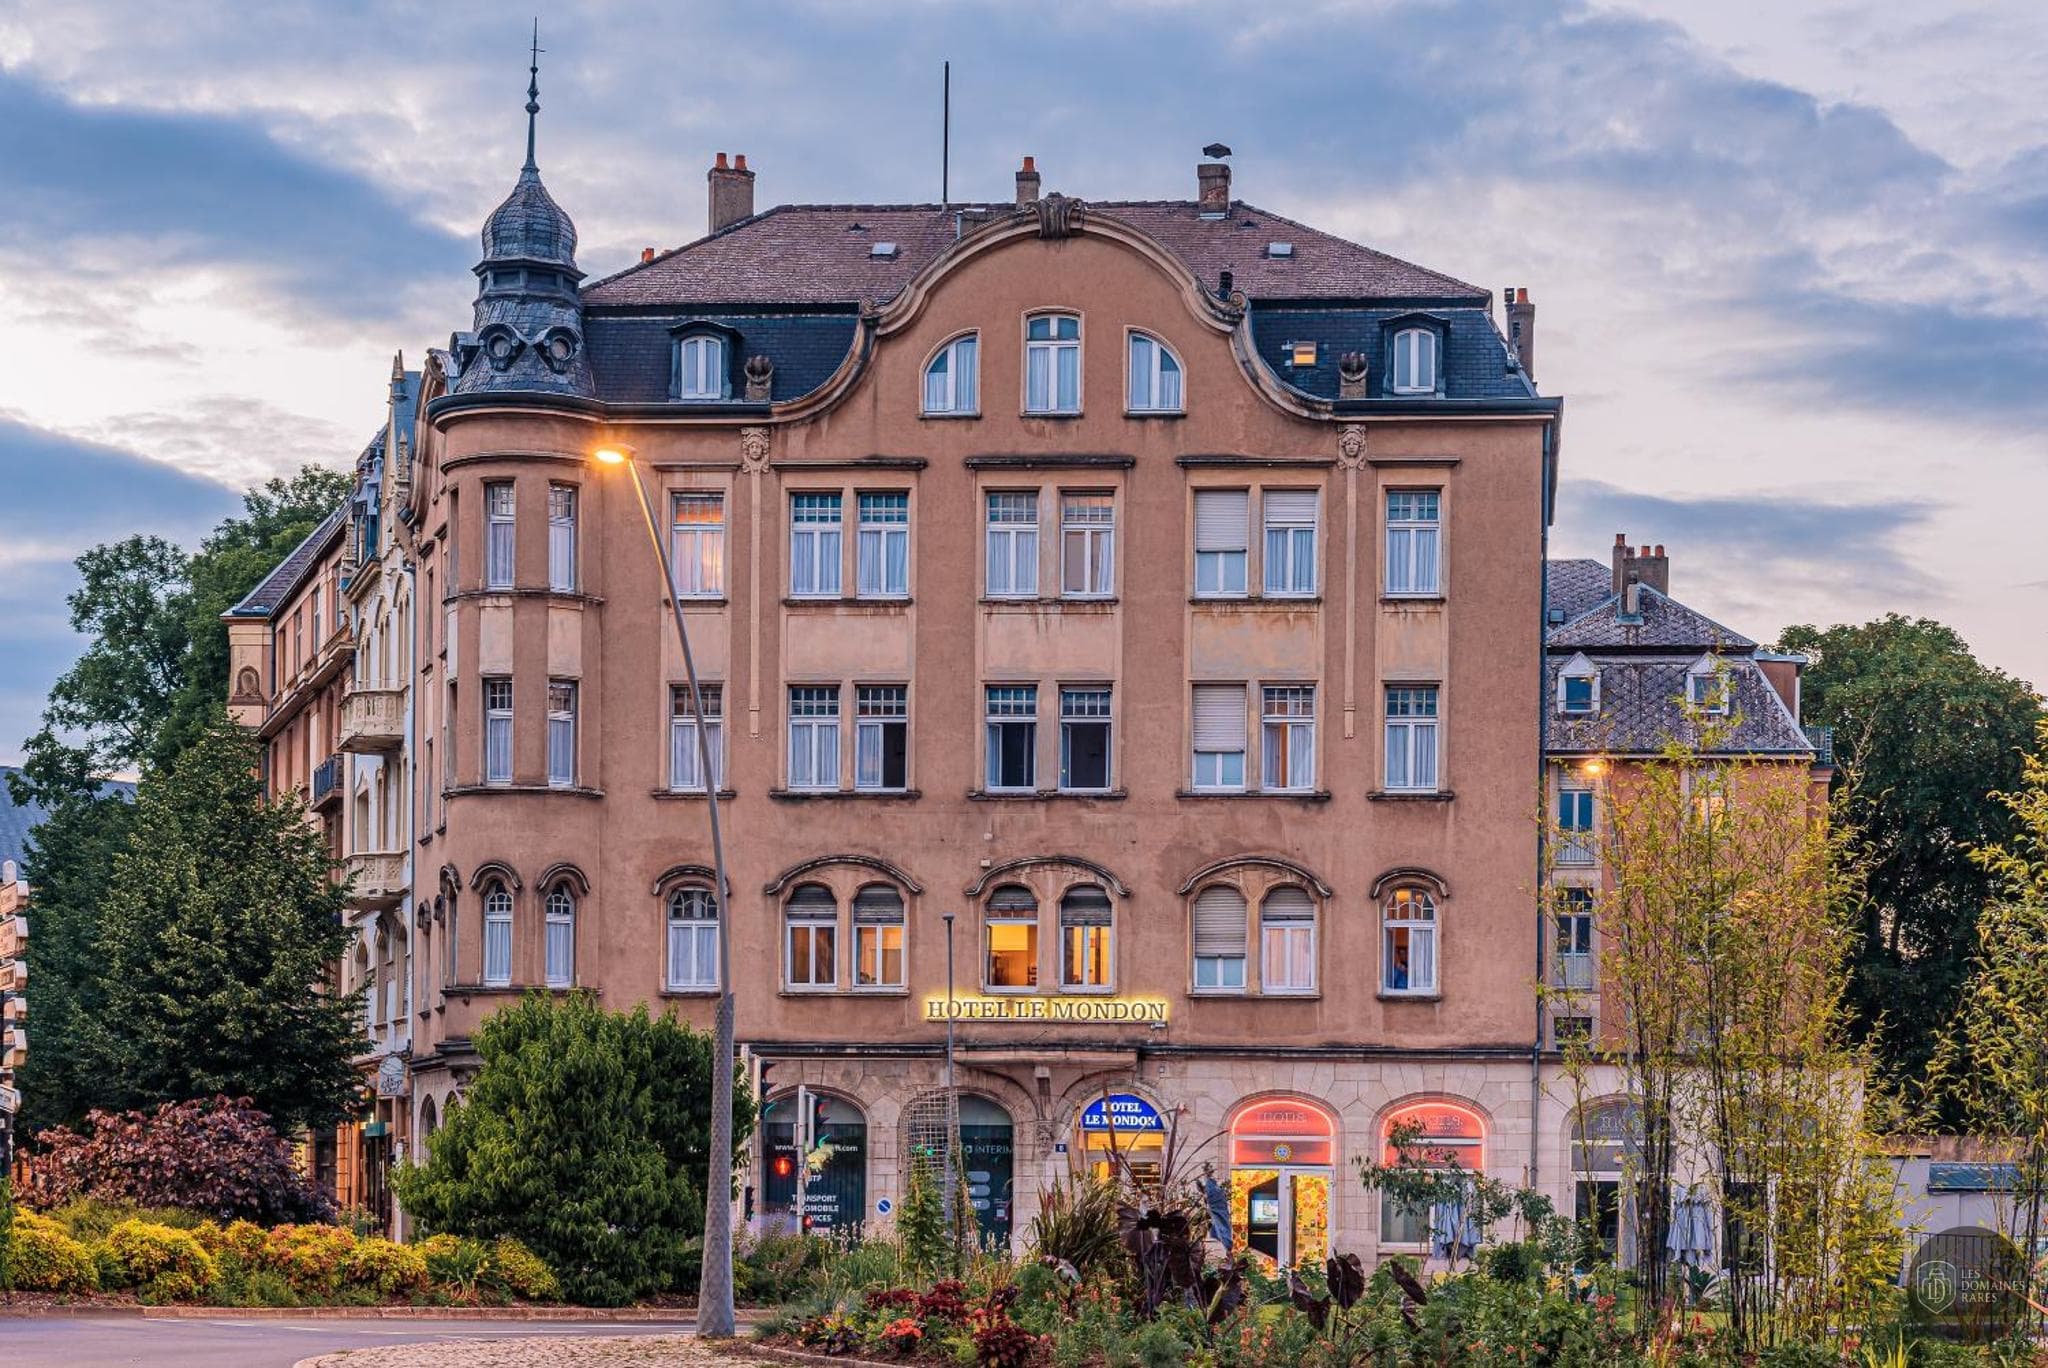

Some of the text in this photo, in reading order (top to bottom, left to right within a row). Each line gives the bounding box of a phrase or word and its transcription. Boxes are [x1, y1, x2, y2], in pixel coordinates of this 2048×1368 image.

[927, 1000, 1166, 1021] HOTEL LE MONDON
[1085, 1114, 1100, 1125] LE
[791, 1194, 837, 1202] TANSPORT
[789, 1204, 839, 1213] AOMOBILE
